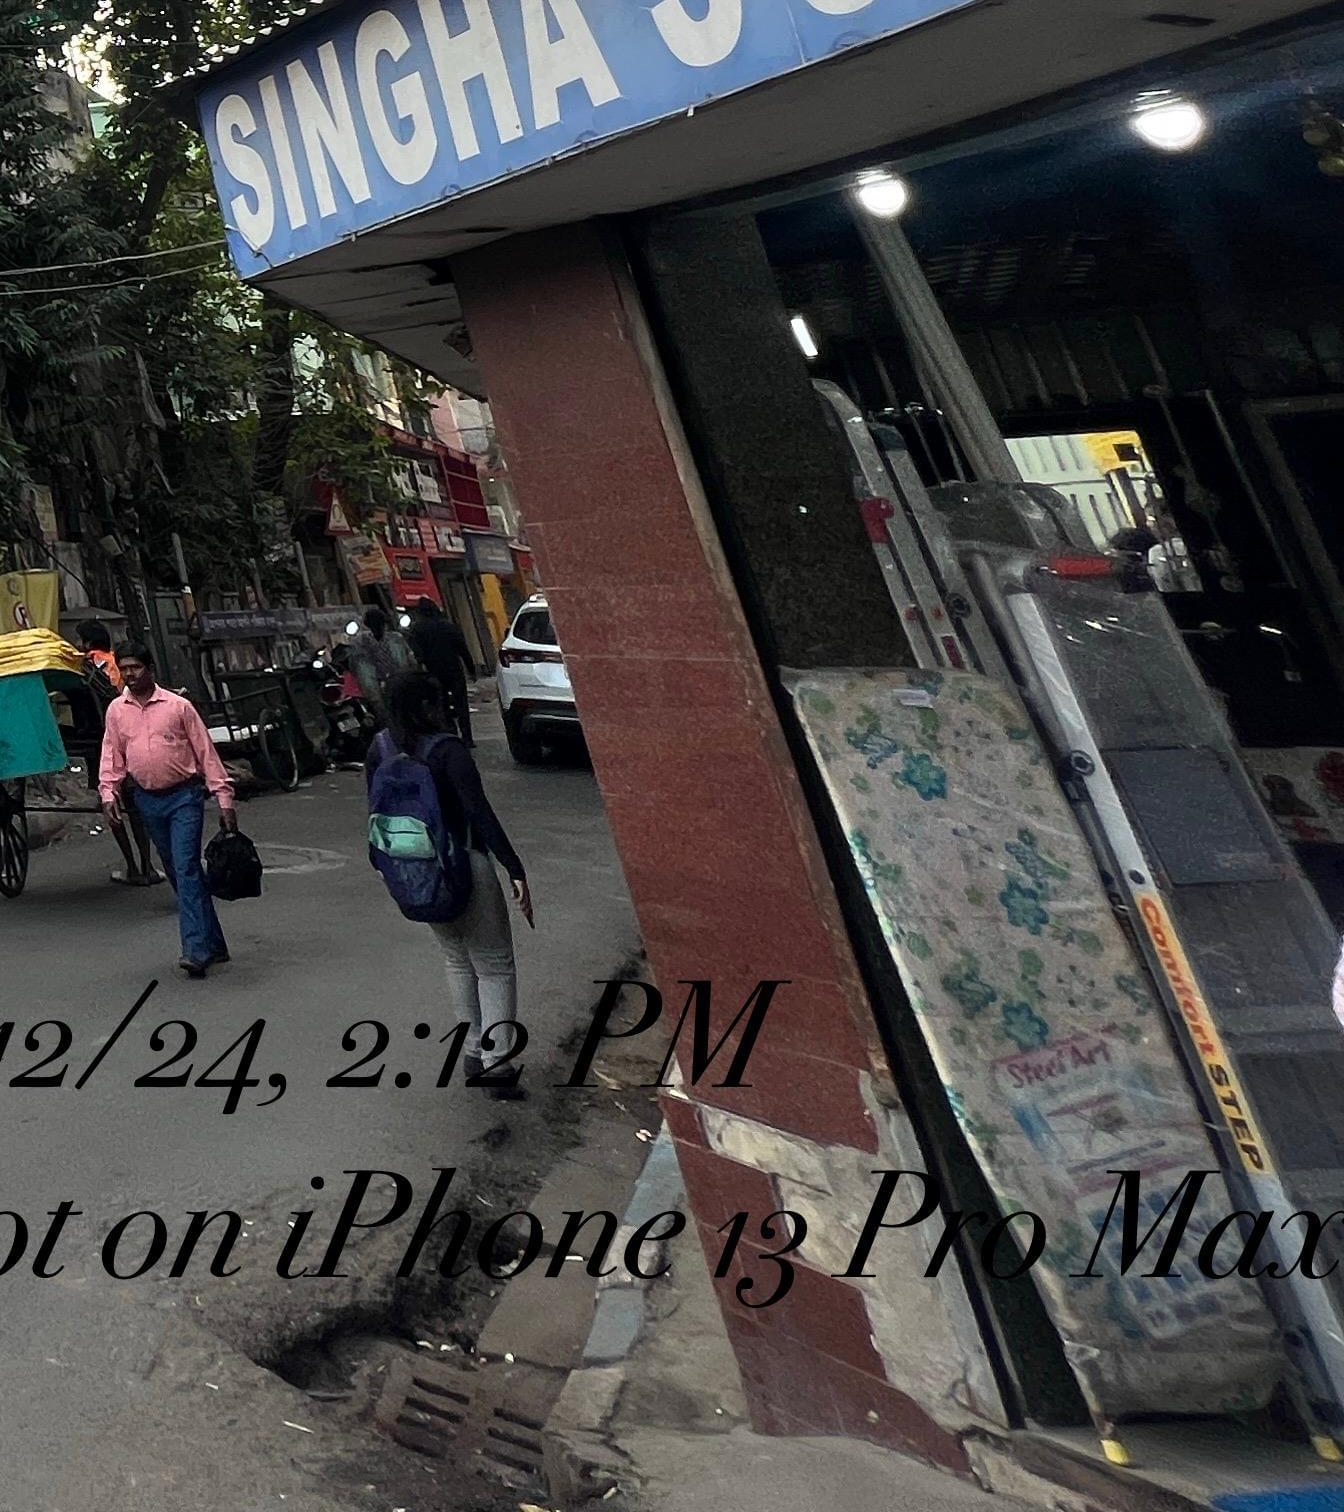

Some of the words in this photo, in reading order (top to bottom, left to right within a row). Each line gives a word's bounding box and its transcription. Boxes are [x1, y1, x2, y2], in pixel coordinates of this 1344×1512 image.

[1068, 1039, 1112, 1070] Art
[1141, 897, 1216, 1056] Comfort
[1209, 1063, 1265, 1172] STEP
